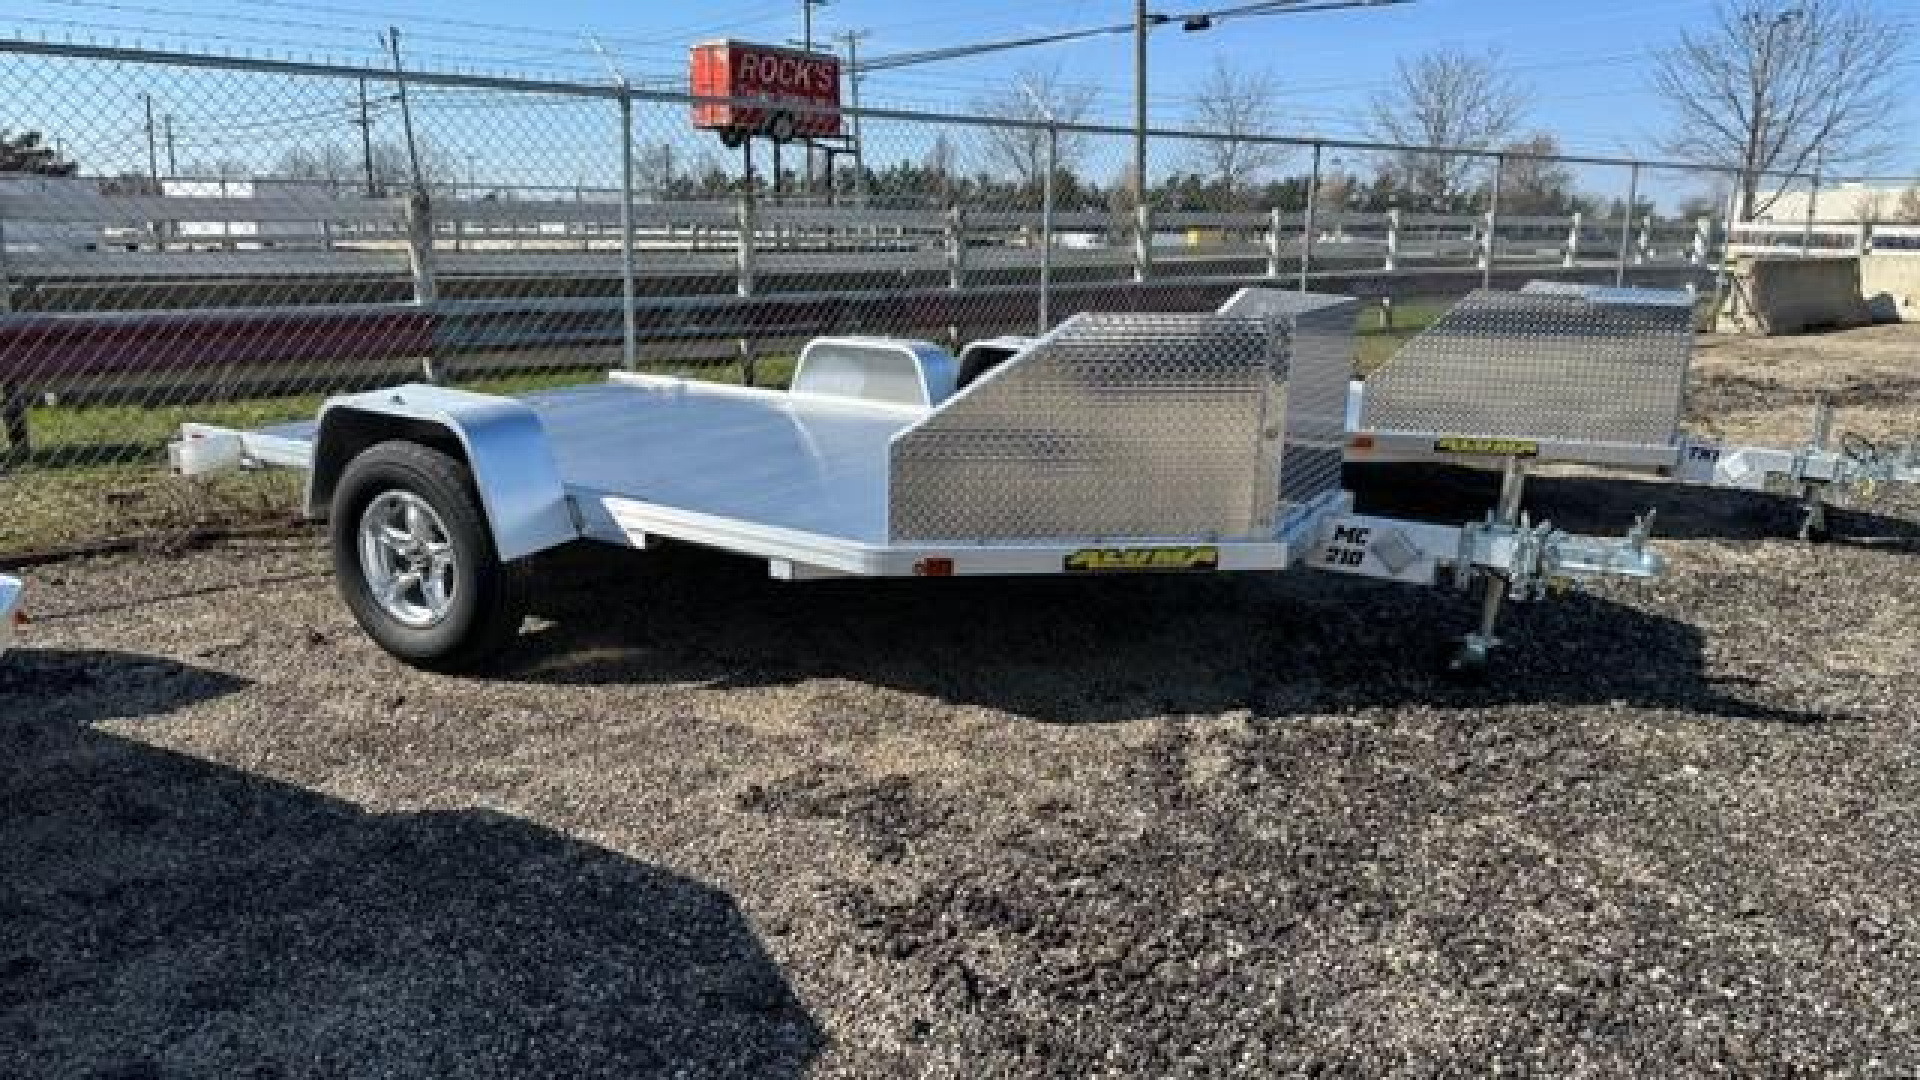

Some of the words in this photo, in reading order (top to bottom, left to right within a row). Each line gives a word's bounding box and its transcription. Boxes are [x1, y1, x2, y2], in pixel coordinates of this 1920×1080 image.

[739, 53, 833, 91] ROCK'S
[1334, 524, 1371, 546] MC
[1066, 547, 1218, 570] ALUMA
[1325, 546, 1366, 567] 210
